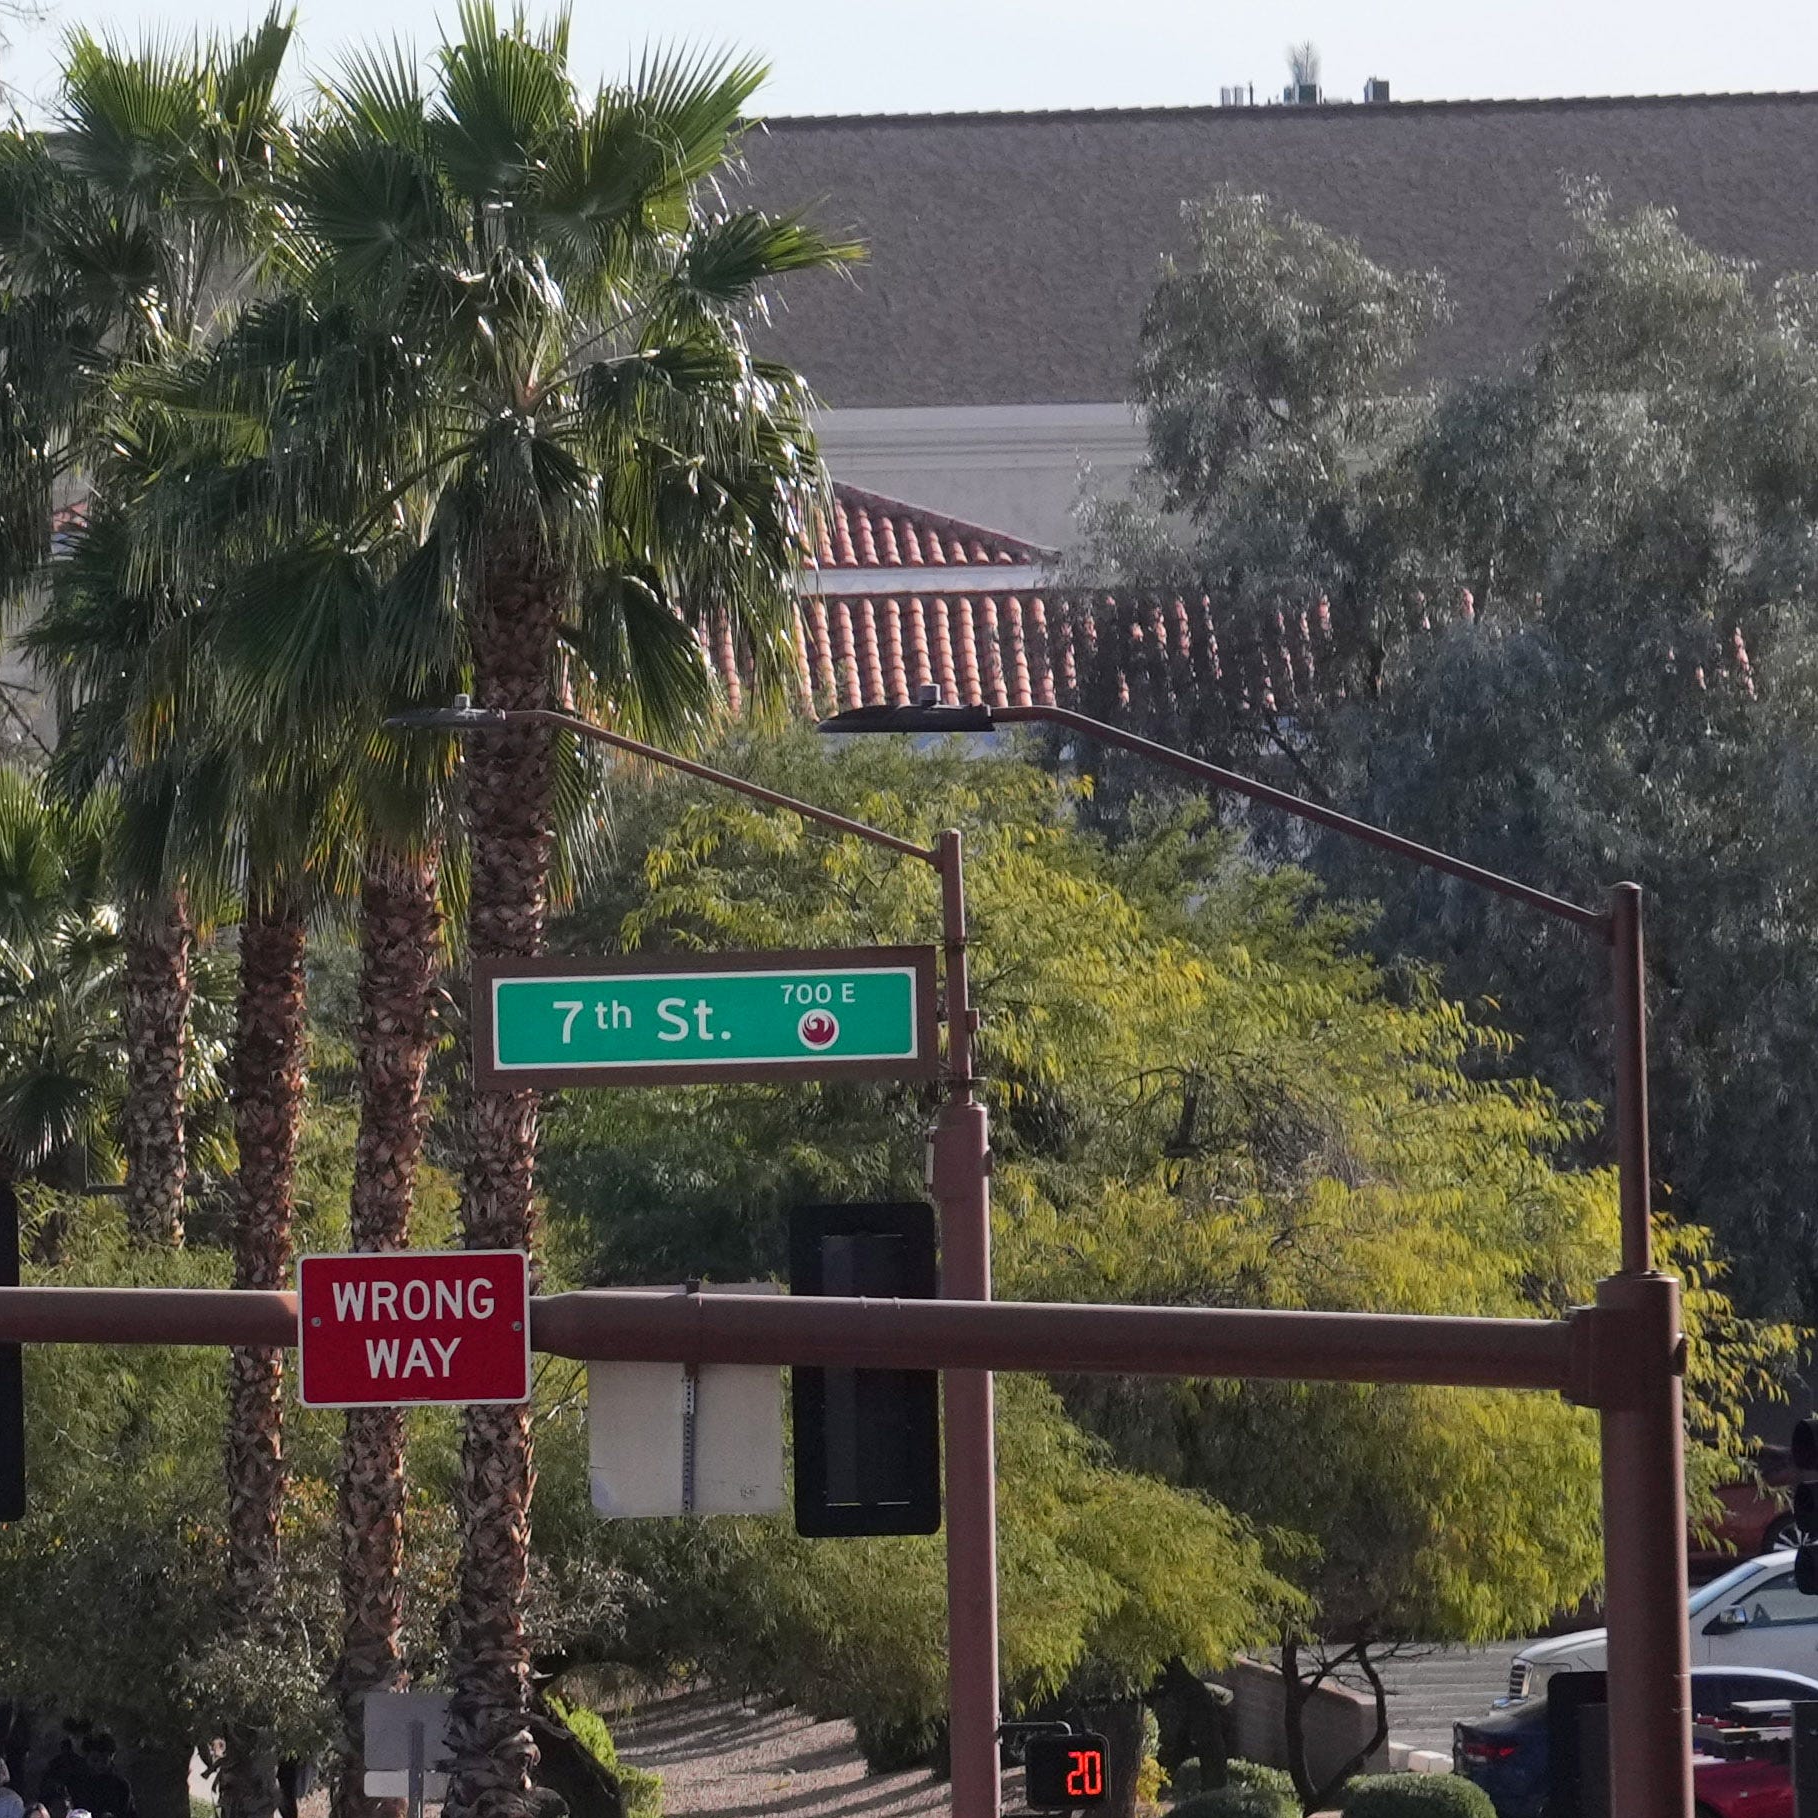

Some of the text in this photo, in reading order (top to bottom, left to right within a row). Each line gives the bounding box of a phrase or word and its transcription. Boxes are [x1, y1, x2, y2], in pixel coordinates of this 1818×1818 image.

[780, 983, 856, 1005] 700 E
[552, 998, 733, 1044] 7th St.
[332, 1278, 495, 1321] WRONG
[365, 1337, 461, 1378] WAY
[1067, 1751, 1101, 1795] 20
